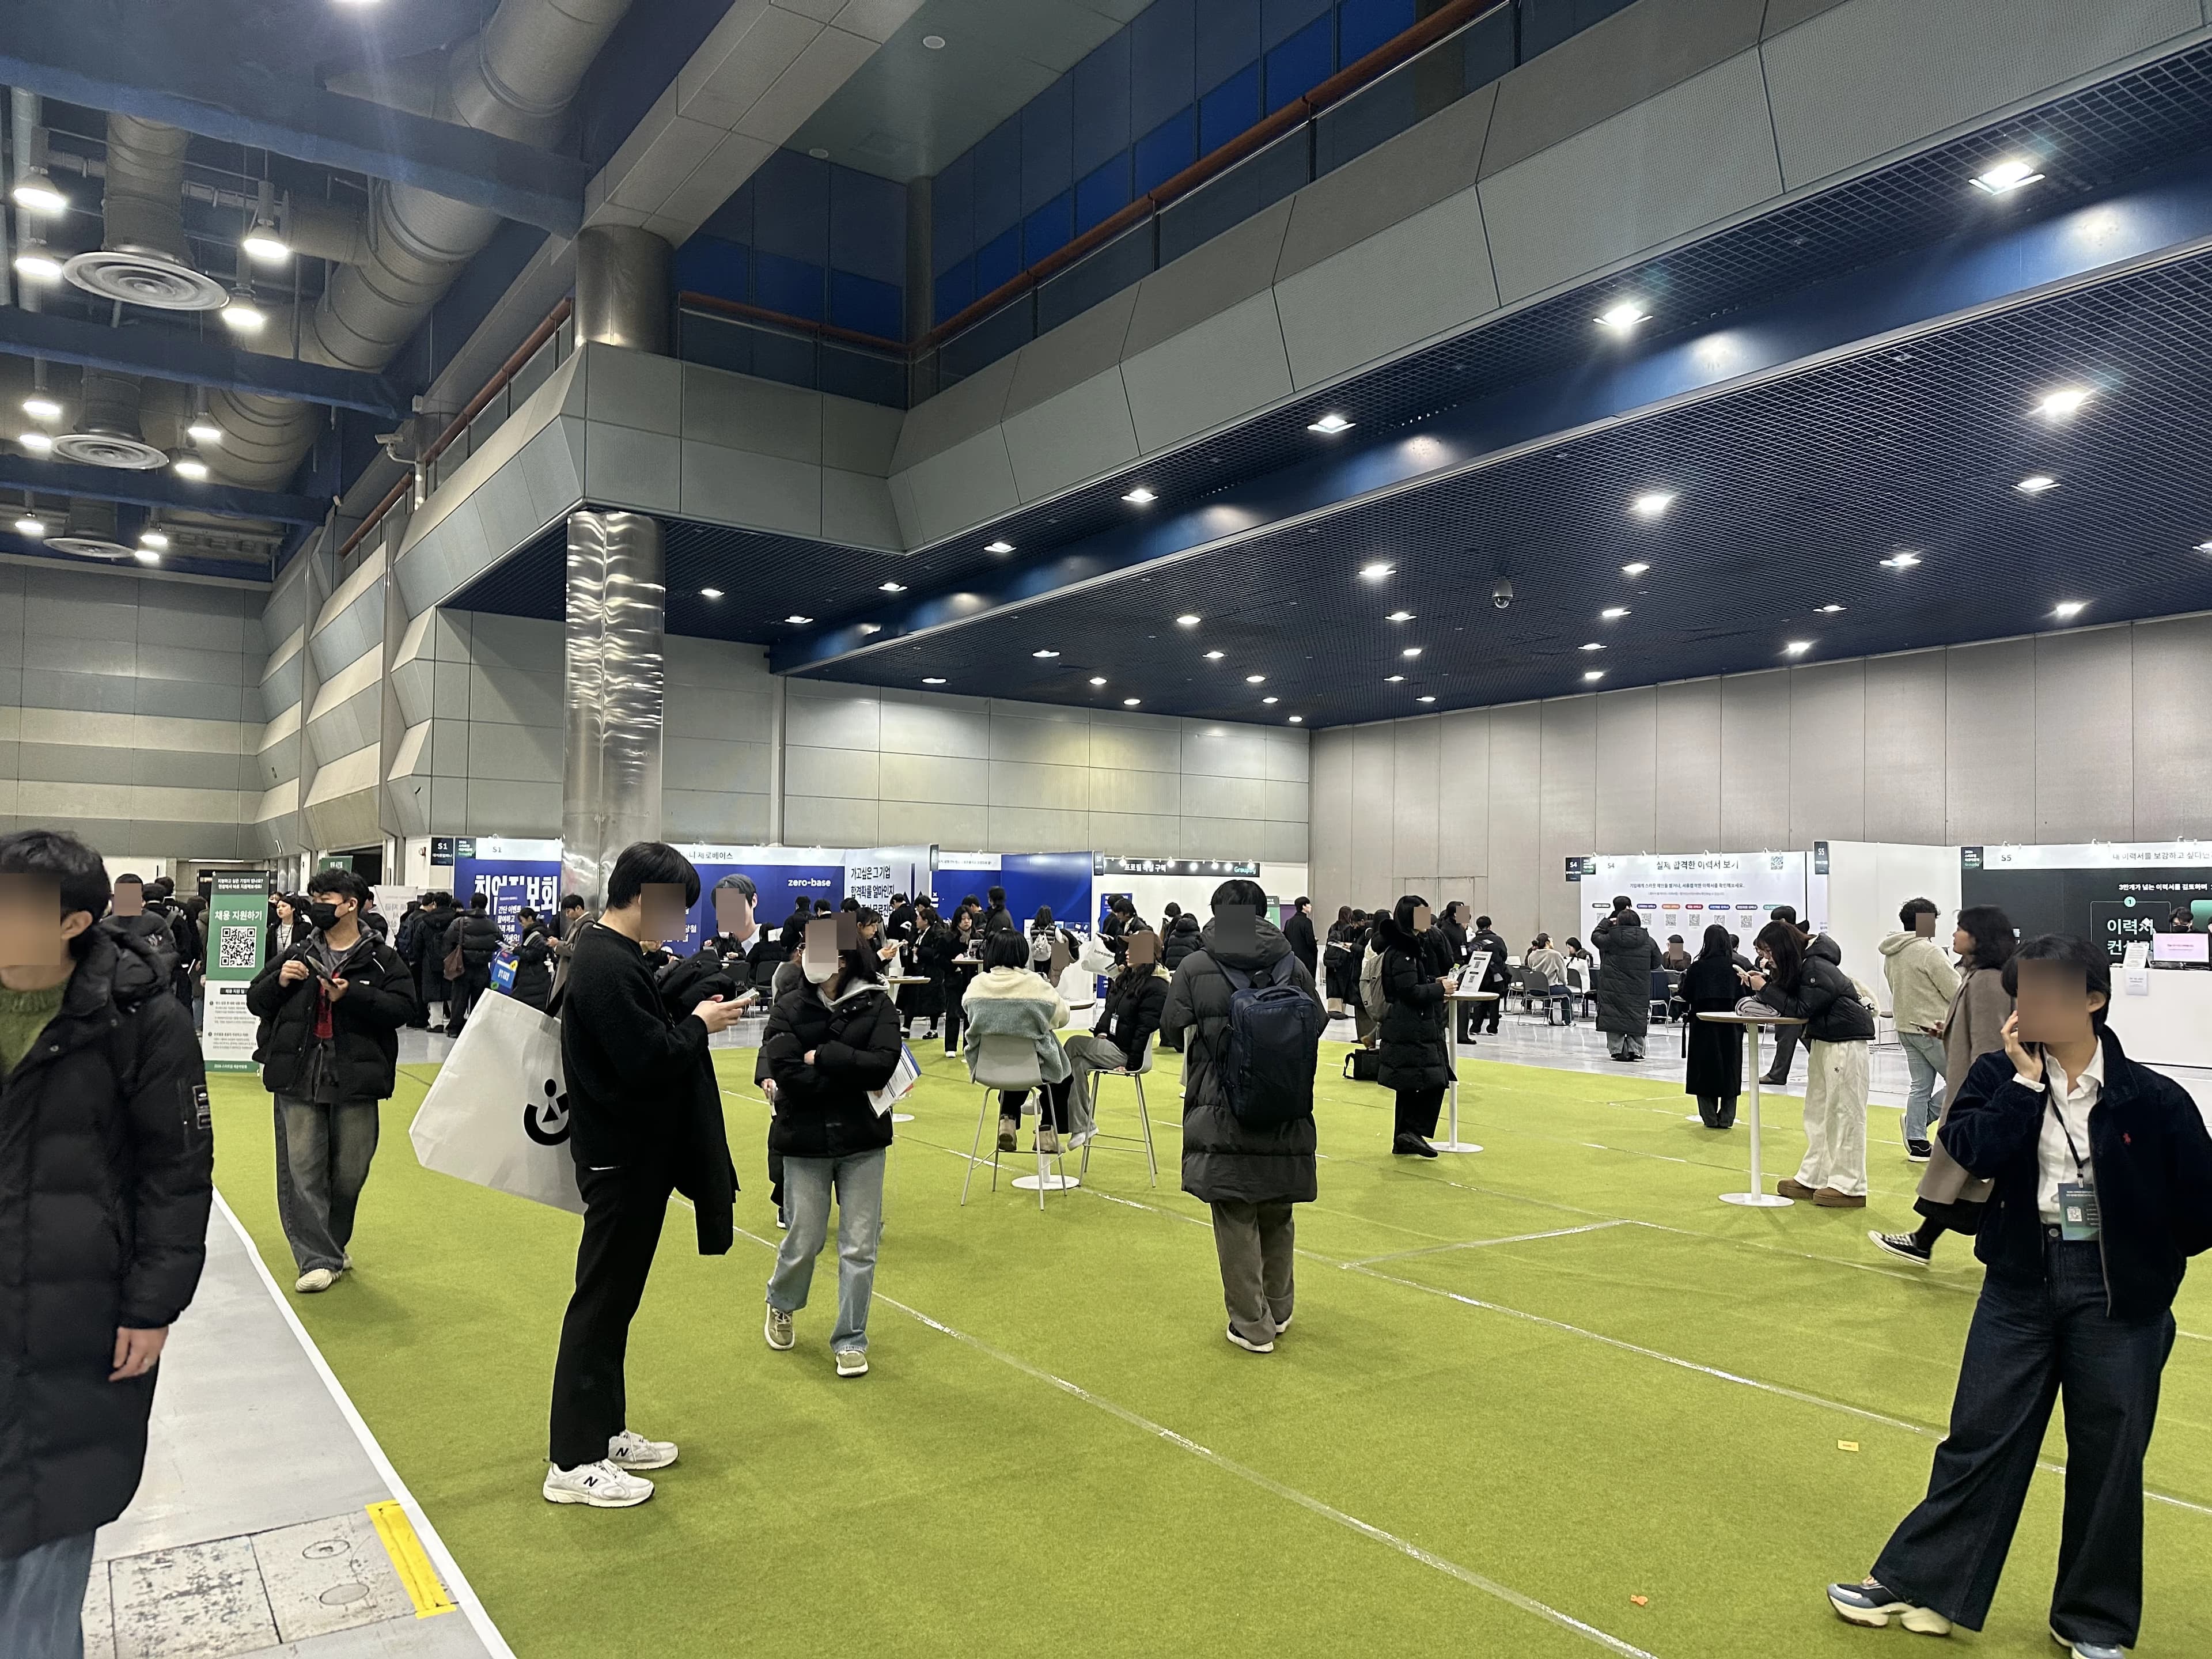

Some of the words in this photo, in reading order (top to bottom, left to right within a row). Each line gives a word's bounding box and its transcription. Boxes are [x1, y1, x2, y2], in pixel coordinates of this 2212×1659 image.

[698, 851, 733, 859] 제로베이스
[2154, 852, 2184, 860] 보강하고
[2187, 851, 2212, 859] 싶다면
[1155, 864, 1166, 872] 구역
[1657, 861, 1671, 870] 실제
[1673, 861, 1695, 870] 합격한
[1698, 860, 1721, 869] 이력서
[1724, 860, 1738, 869] 보기
[851, 866, 872, 880] 가고싶은
[788, 878, 831, 887] zero-base
[851, 885, 872, 899] 합격확률
[873, 884, 894, 899] 얼마인지
[498, 906, 507, 914] 간단
[508, 905, 521, 914] 이벤트
[215, 910, 230, 921] 채용
[232, 910, 262, 921] 지원하기
[498, 915, 515, 923] 참여하고
[506, 925, 515, 933] 자료
[616, 1448, 629, 1457] N
[584, 1476, 599, 1487] N
